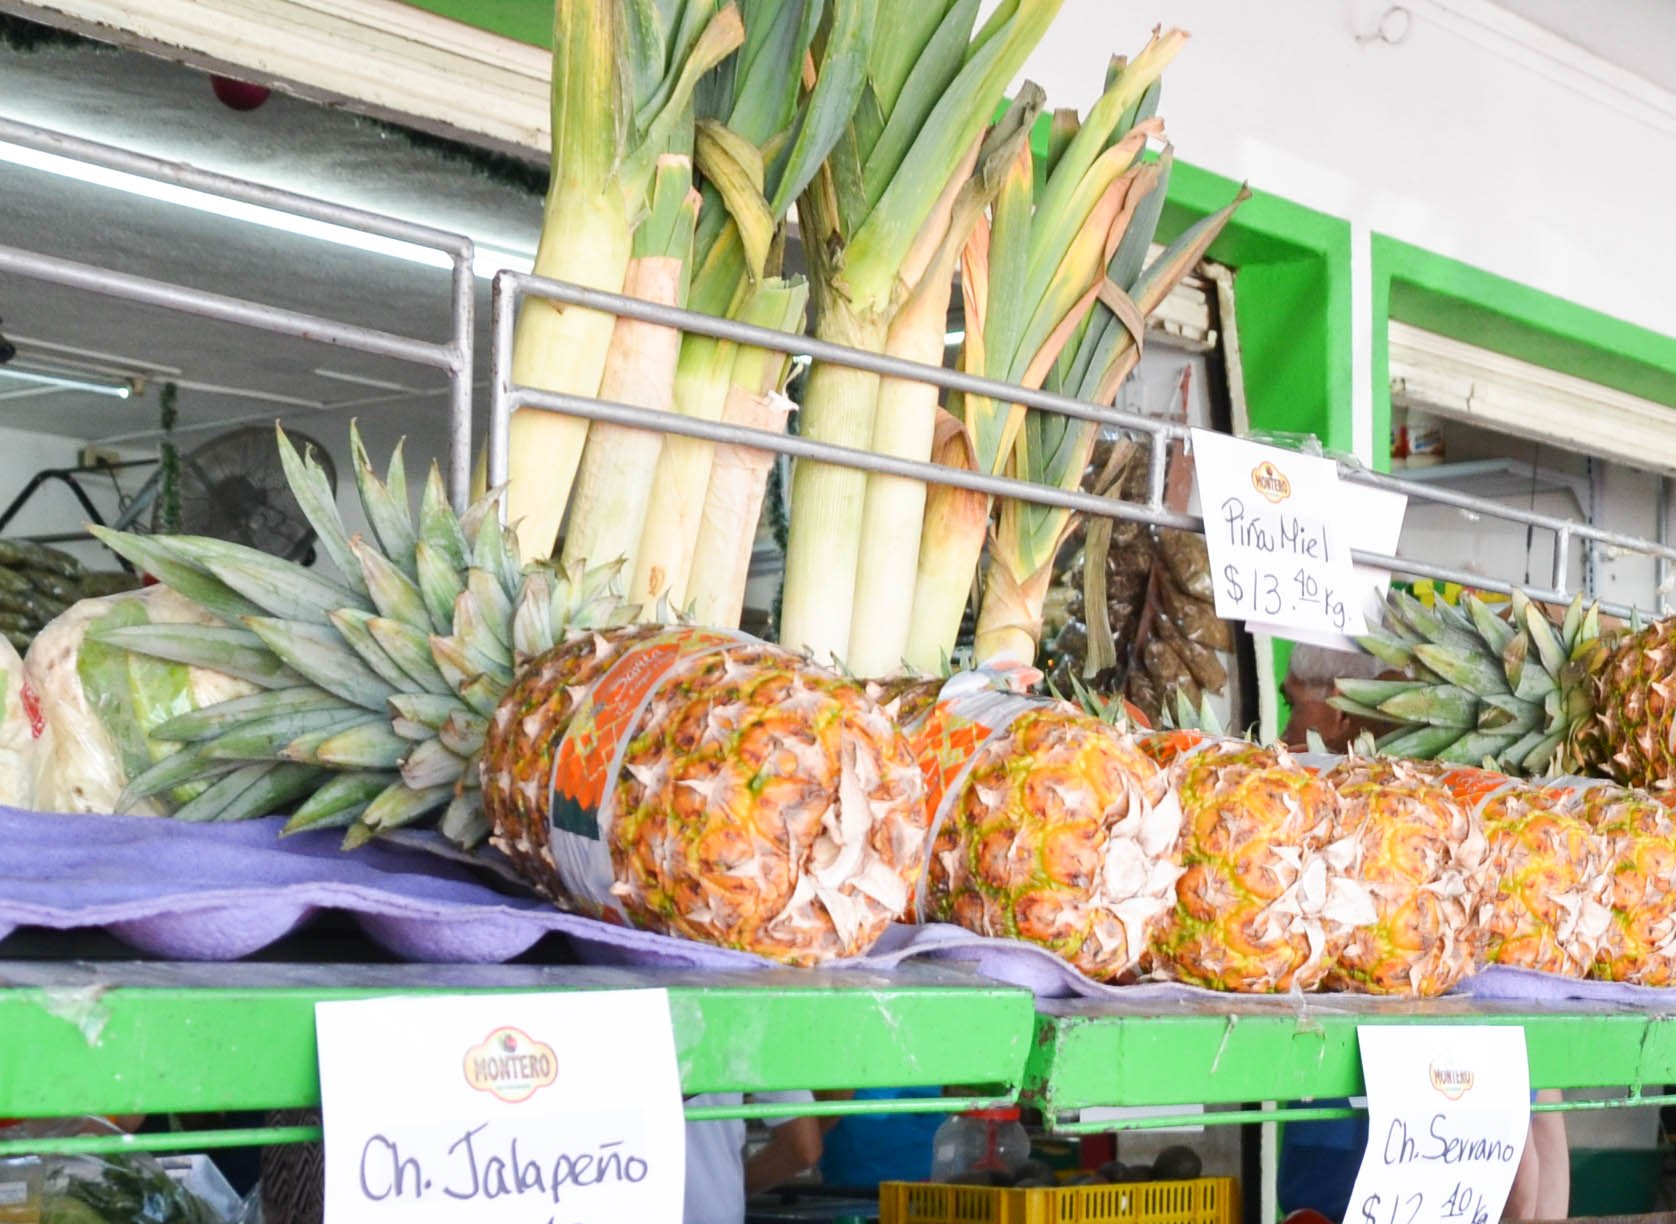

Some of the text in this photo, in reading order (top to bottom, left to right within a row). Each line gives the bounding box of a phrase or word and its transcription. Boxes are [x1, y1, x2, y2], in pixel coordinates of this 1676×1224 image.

[1280, 513, 1329, 563] Miel
[473, 1053, 551, 1083] MONTERO
[359, 1121, 648, 1204] Ch. Jalapeño
[1384, 1113, 1514, 1165] Ch. Serrano
